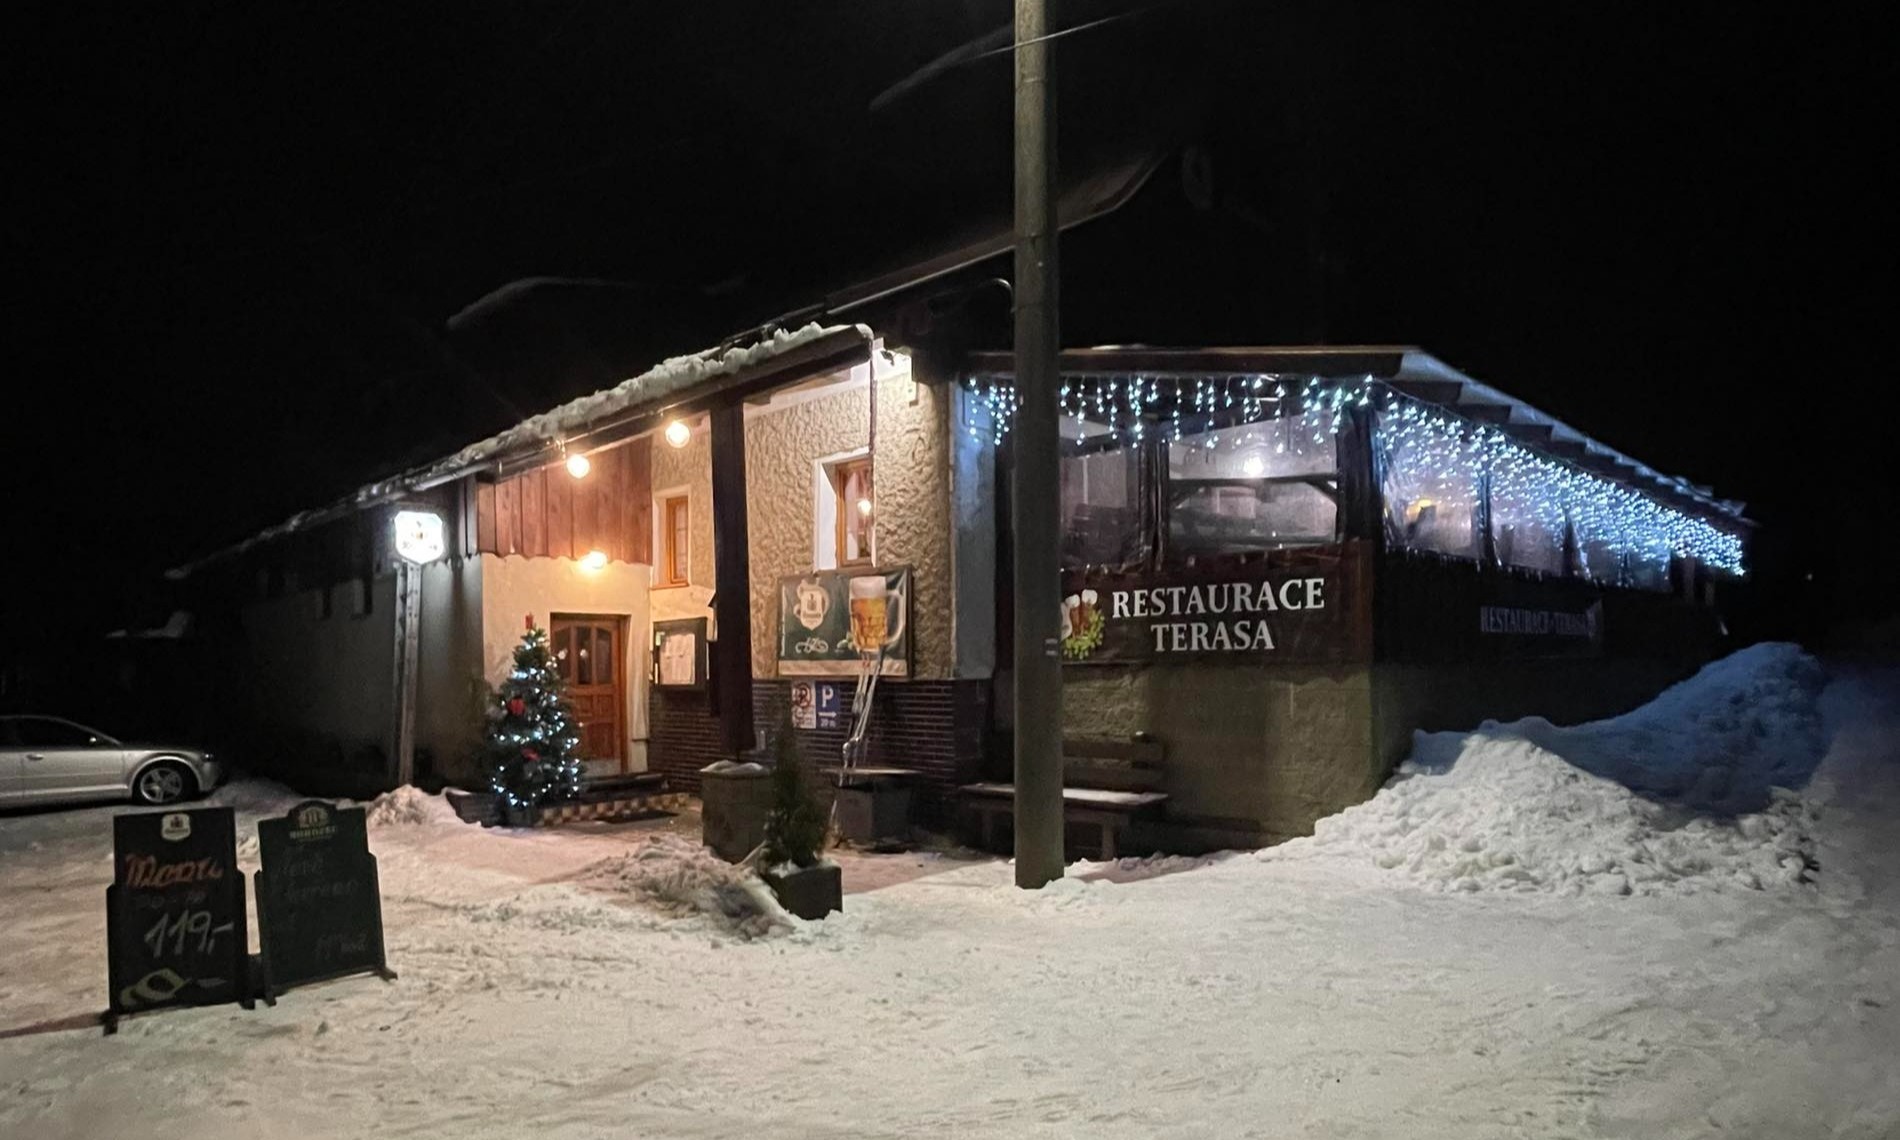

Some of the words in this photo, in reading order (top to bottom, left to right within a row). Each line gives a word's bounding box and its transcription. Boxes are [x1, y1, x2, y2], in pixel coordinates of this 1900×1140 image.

[1112, 578, 1326, 618] RESTAURACE
[1151, 620, 1276, 652] TERASA
[822, 685, 834, 708] P
